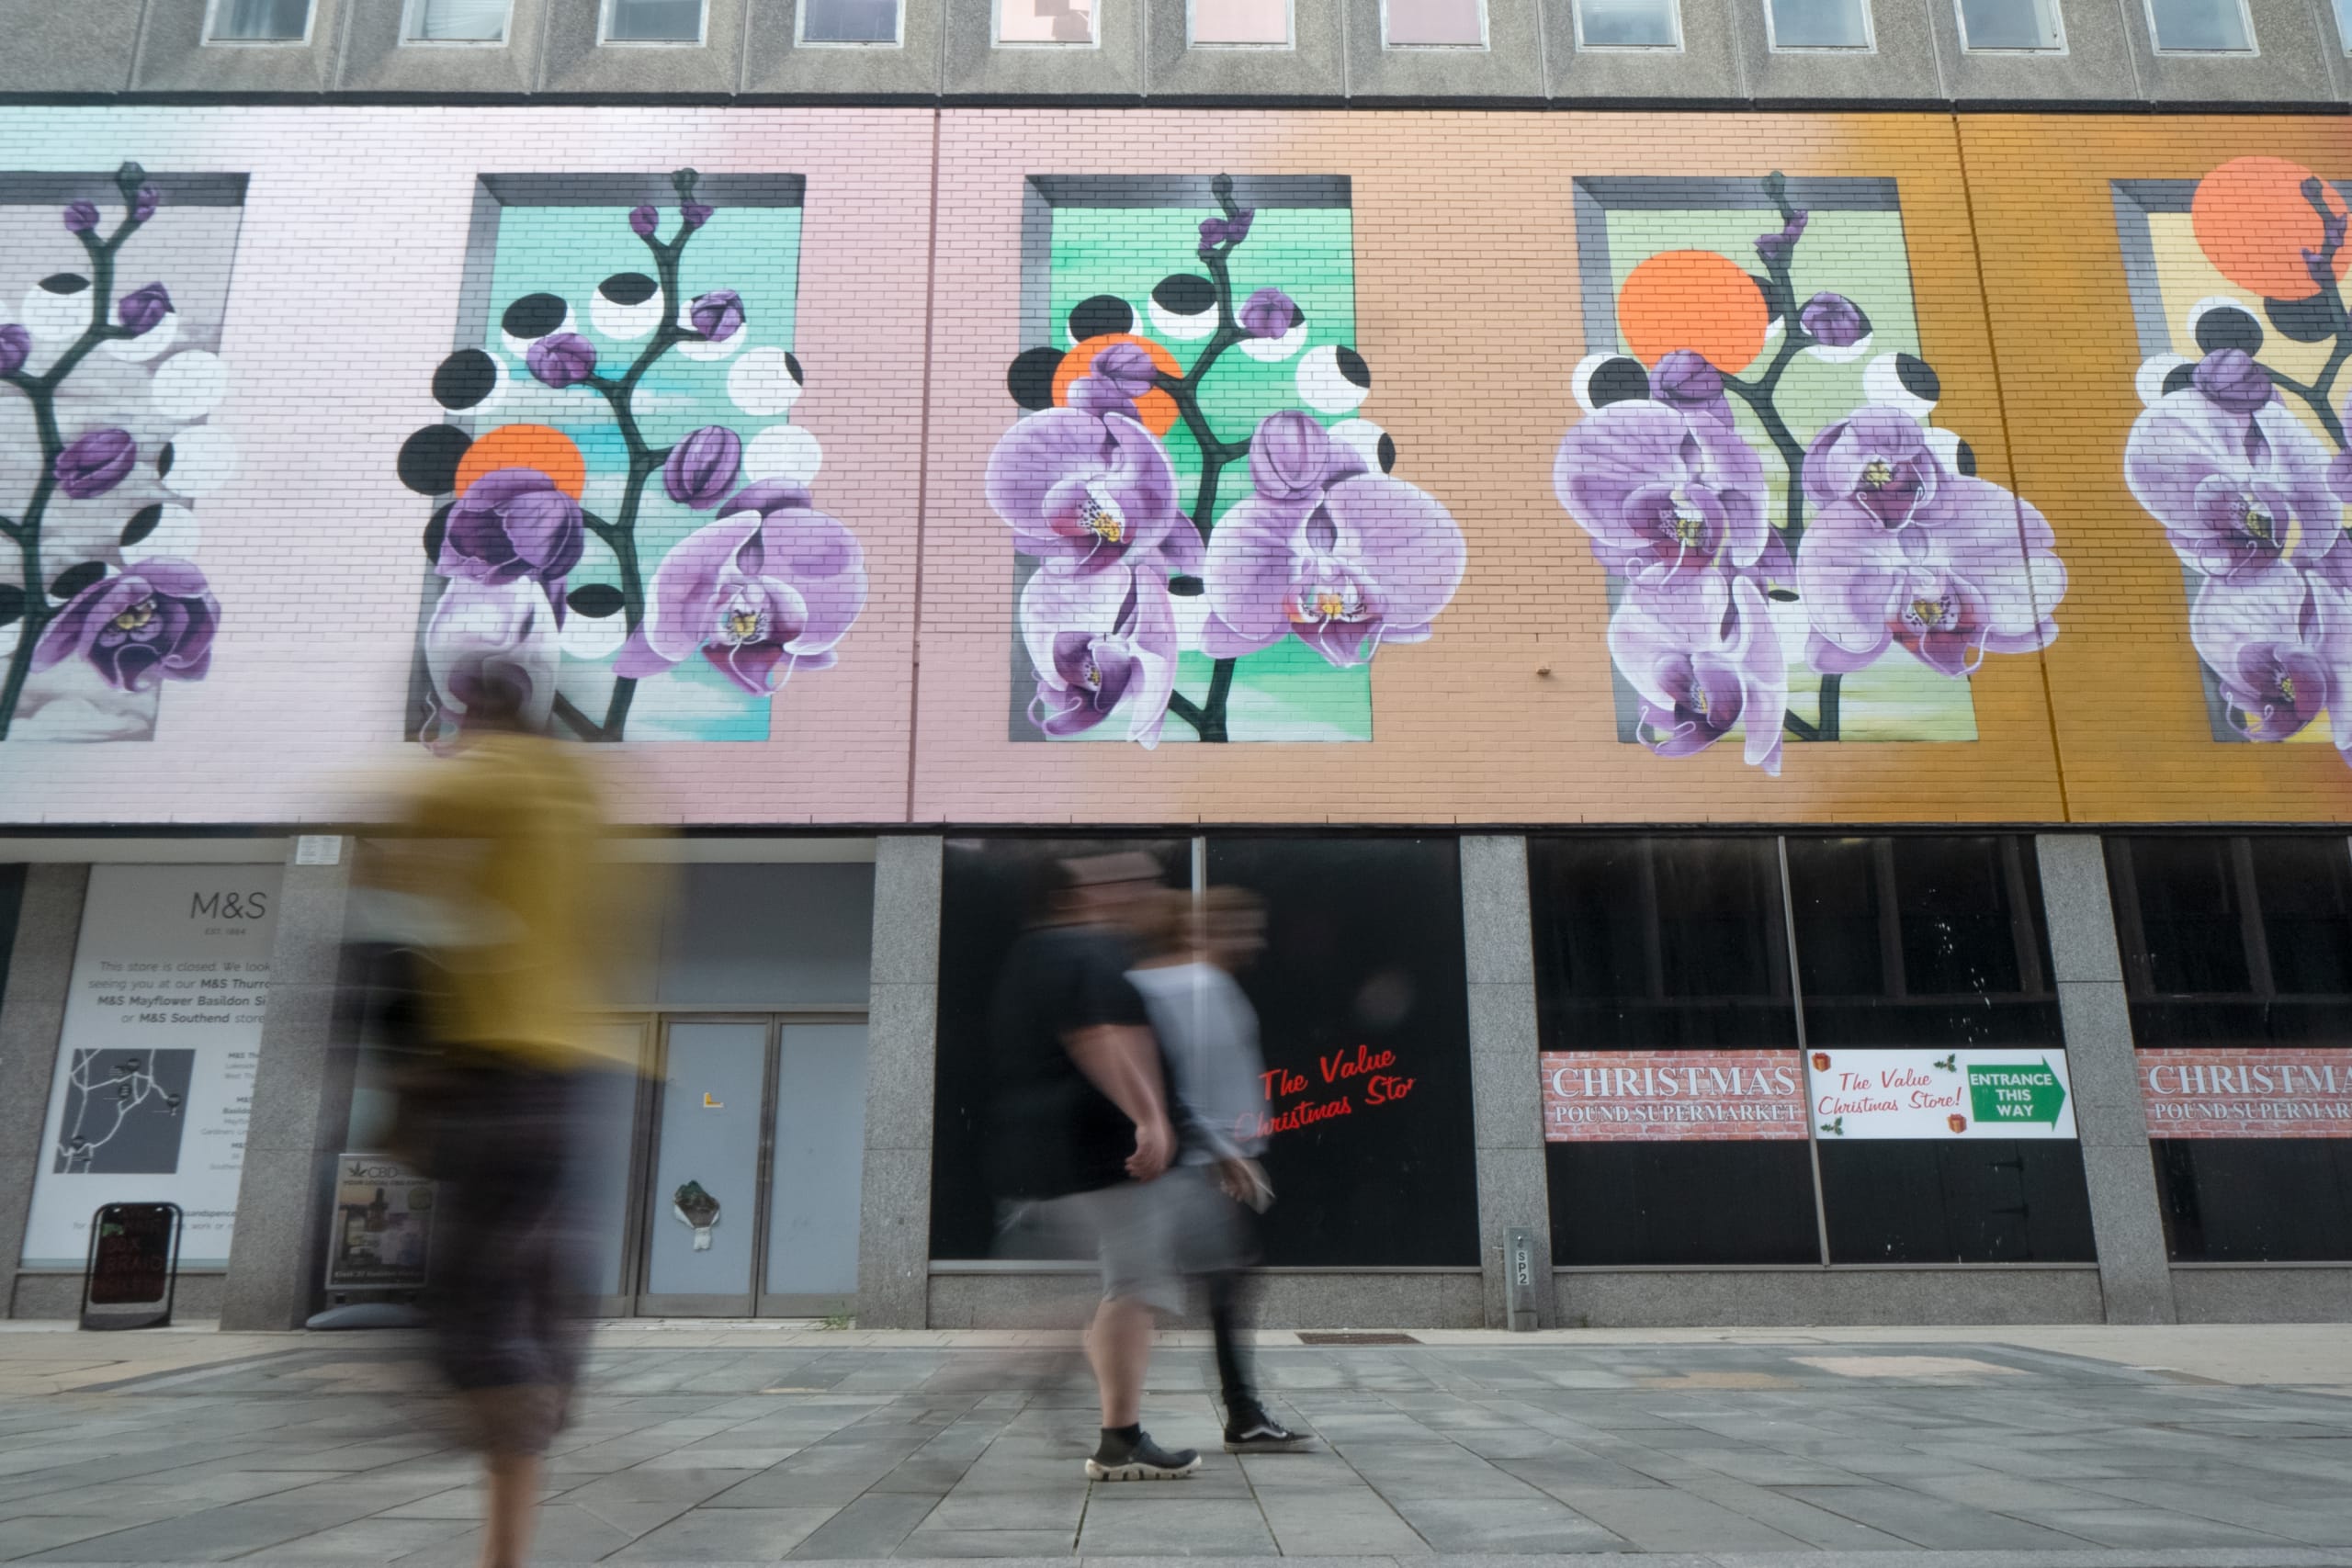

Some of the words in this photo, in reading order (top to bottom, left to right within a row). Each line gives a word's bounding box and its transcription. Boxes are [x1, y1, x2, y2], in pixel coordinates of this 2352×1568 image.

[189, 891, 267, 919] M&S
[100, 961, 123, 972] This
[127, 961, 158, 972] store
[163, 962, 172, 972] is
[223, 962, 242, 972] We
[88, 979, 127, 991] seeing
[131, 980, 154, 991] you
[159, 979, 170, 988] at
[175, 980, 196, 988] our
[200, 978, 228, 988] M&S
[96, 996, 124, 1006] M&S
[129, 995, 193, 1009] Mayflower
[197, 995, 250, 1006] Basildon
[121, 1015, 135, 1023] or
[140, 1013, 166, 1023] M&S
[171, 1013, 230, 1023] Southend
[1259, 1069, 1308, 1100] The
[1320, 1044, 1396, 1083] Value
[1838, 1072, 1871, 1091] The
[1882, 1068, 1932, 1089] Value
[1970, 1073, 2052, 1087] ENTRANCE
[1553, 1066, 1795, 1097] CHRISTMAS
[1817, 1095, 1899, 1115] Christmas
[1907, 1087, 1962, 1110] Store!
[1996, 1089, 2031, 1101] THIS
[1555, 1105, 1630, 1122] POUND
[1635, 1104, 1796, 1122] SUPERMARKET
[1996, 1104, 2034, 1117] WAY
[2154, 1102, 2228, 1120] POUND
[1234, 1097, 1351, 1143] Christmas
[368, 1166, 398, 1179] CBD
